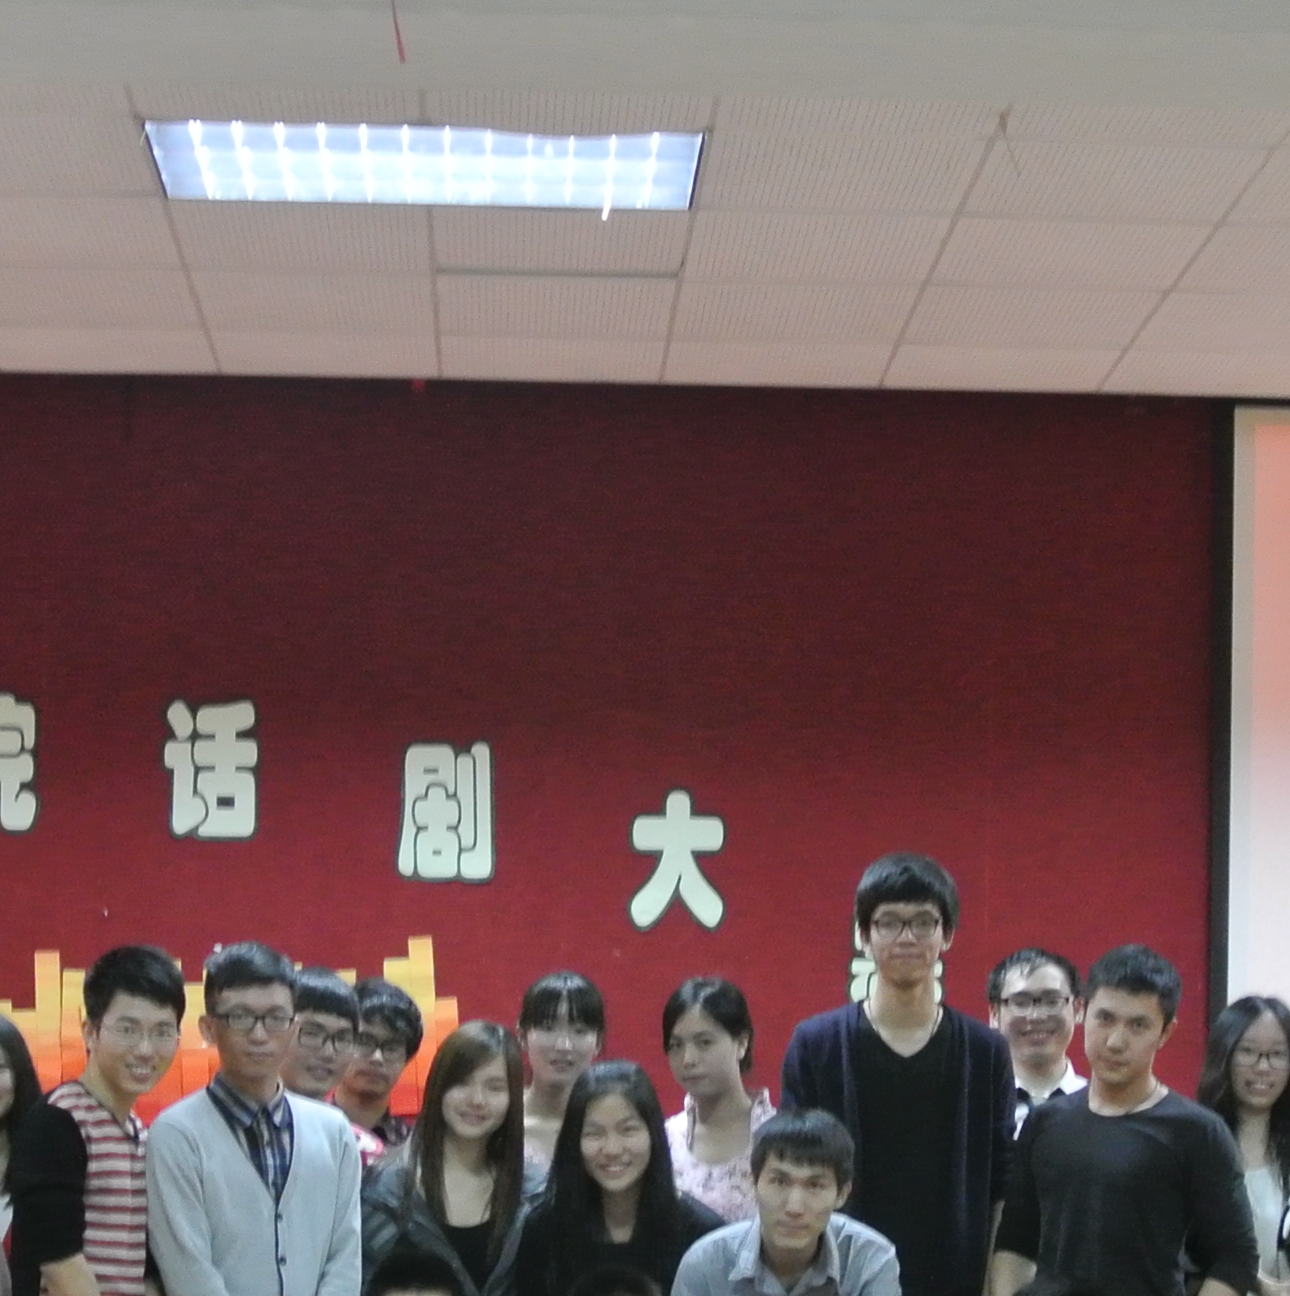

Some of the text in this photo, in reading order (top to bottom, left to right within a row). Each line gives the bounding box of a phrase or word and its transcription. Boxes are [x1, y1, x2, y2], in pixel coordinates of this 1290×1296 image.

[162, 698, 260, 841] 话
[395, 740, 497, 884] 剧
[627, 787, 727, 932] 大
